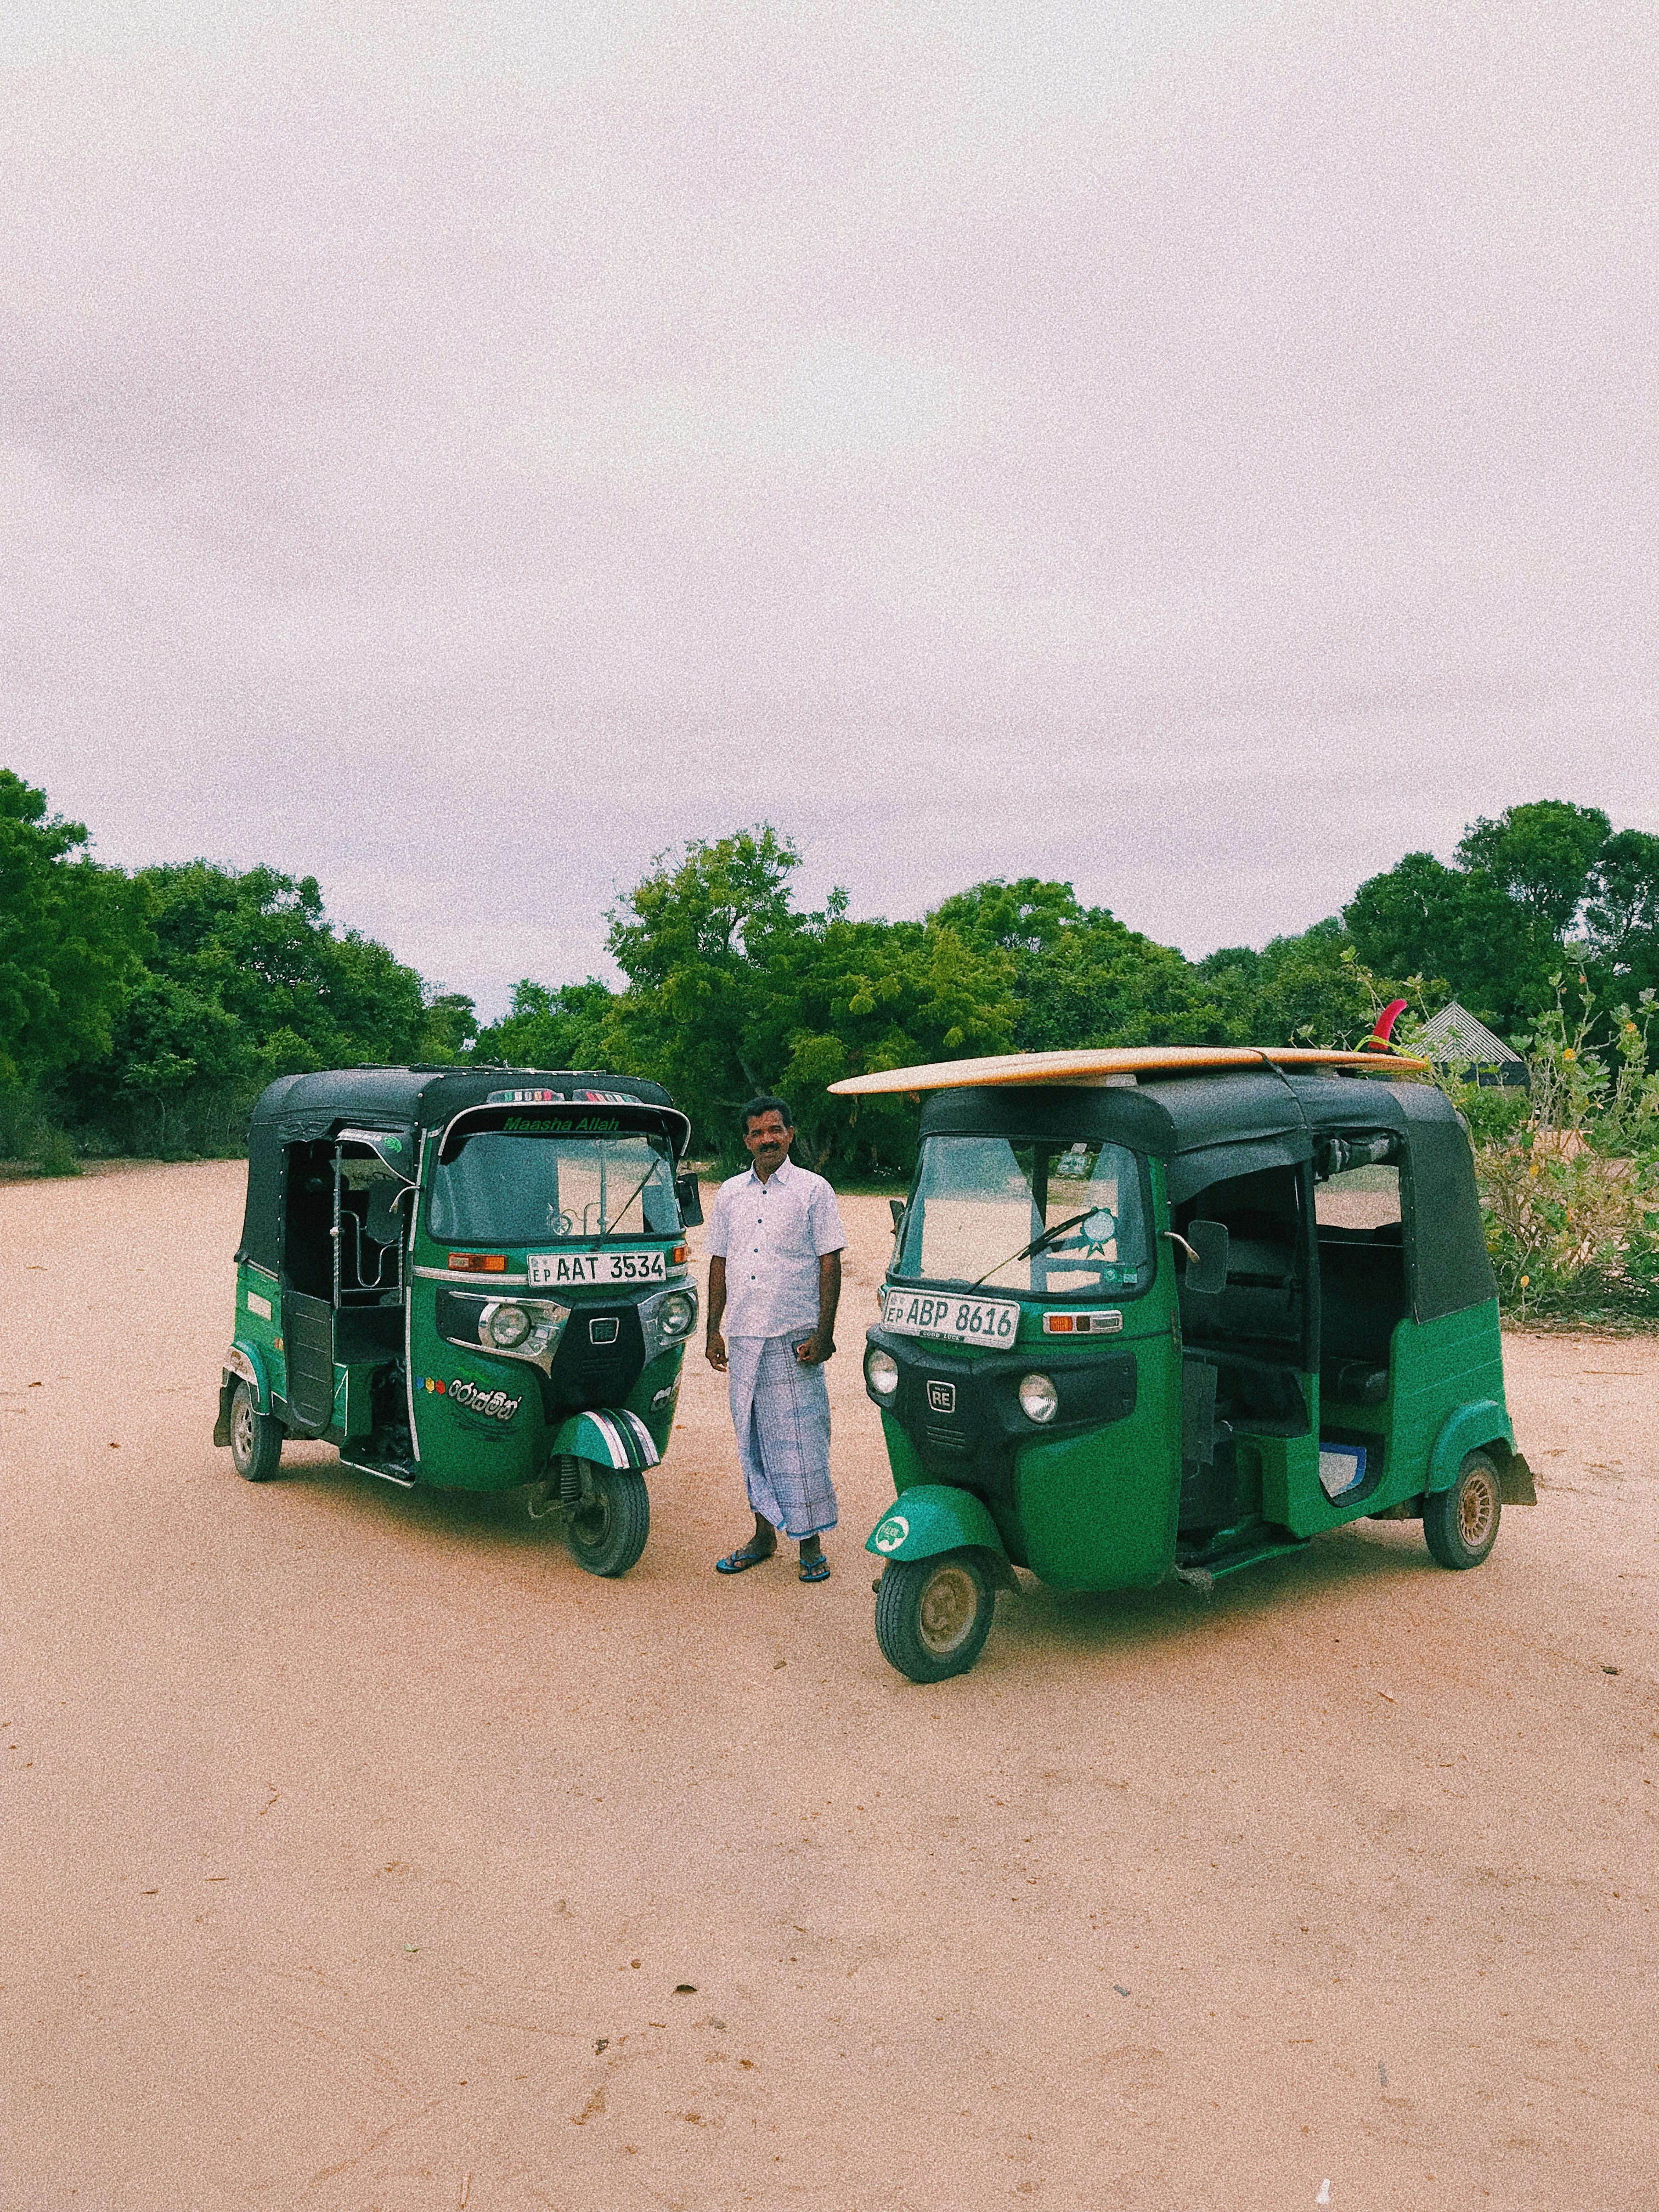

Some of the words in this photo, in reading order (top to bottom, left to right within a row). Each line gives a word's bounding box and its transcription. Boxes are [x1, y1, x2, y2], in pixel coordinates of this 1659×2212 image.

[503, 1117, 573, 1131] Maasha
[576, 1117, 619, 1131] Allah
[534, 1269, 551, 1282] EP
[557, 1257, 598, 1280] AAT
[610, 1255, 663, 1278] 3534
[887, 1307, 903, 1322] EP
[906, 1298, 948, 1327] ABP
[956, 1304, 1011, 1337] 8616
[932, 1391, 950, 1406] RE
